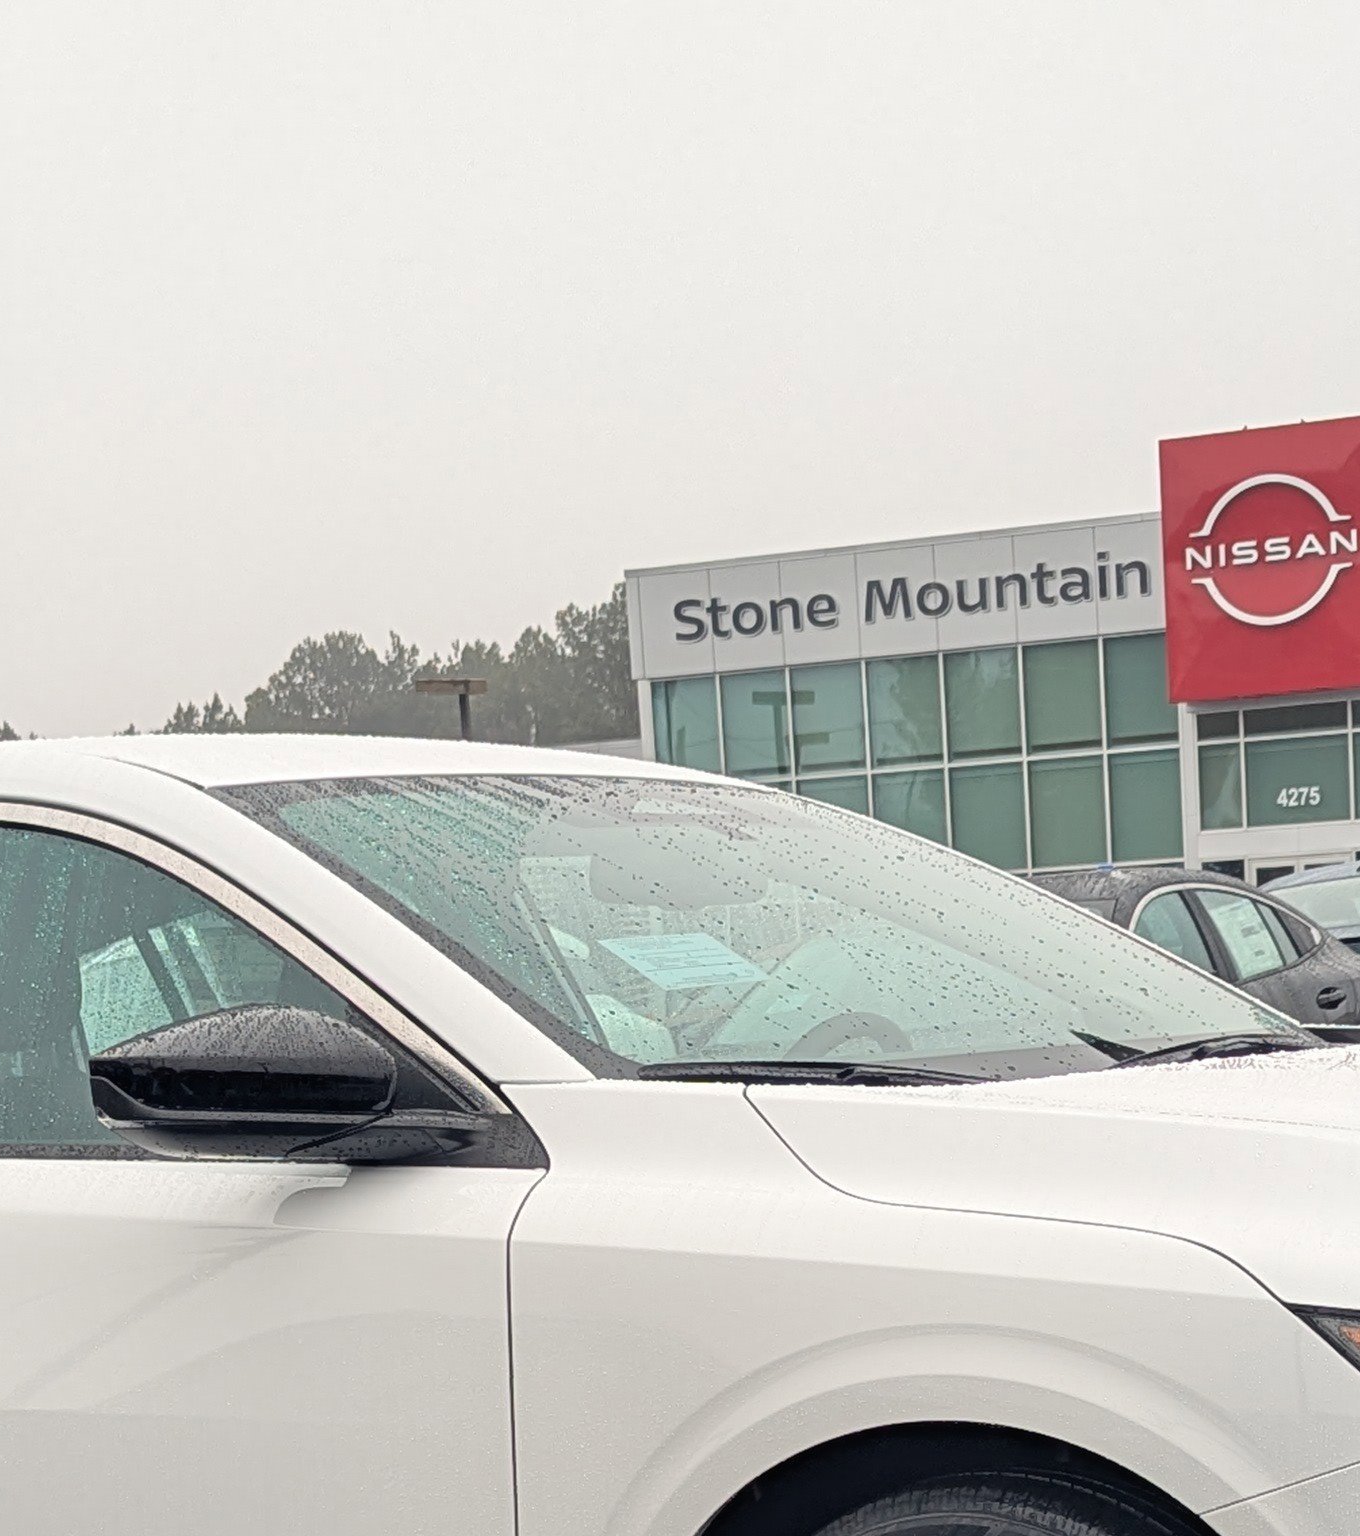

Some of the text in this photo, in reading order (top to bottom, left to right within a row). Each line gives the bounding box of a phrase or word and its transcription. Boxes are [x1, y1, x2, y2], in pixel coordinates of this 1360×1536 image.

[1185, 528, 1358, 571] NISSAN
[673, 550, 1151, 642] Stone Mountain
[1276, 785, 1321, 807] 4275
